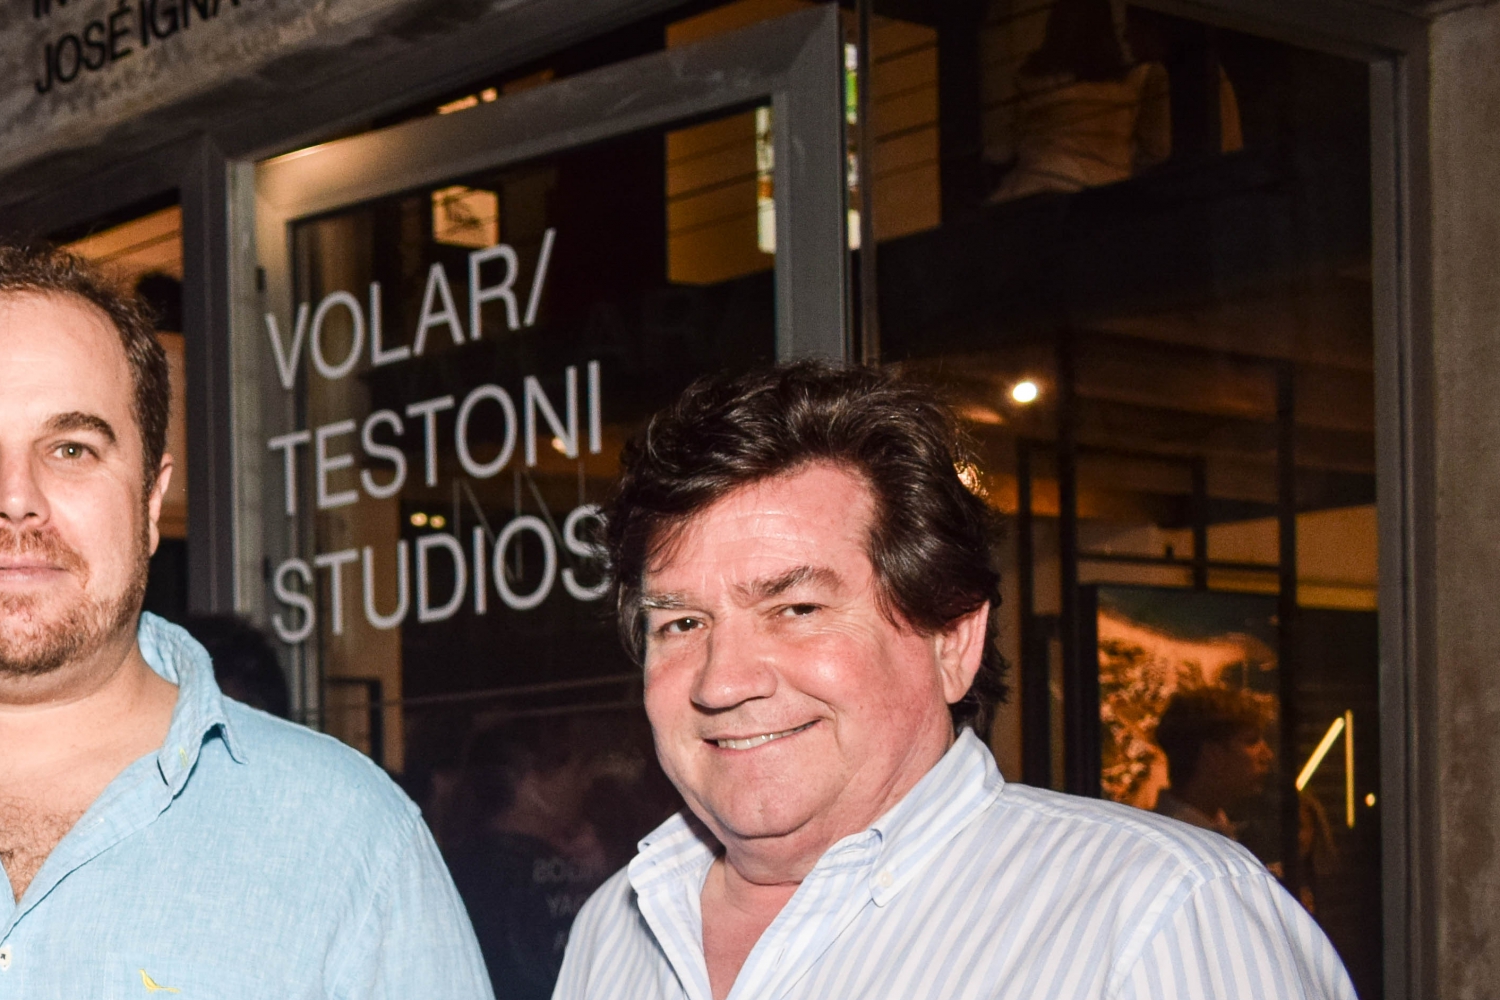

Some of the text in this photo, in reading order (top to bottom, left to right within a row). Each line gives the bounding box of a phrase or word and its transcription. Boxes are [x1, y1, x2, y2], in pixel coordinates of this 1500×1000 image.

[264, 227, 557, 391] VOLAR/
[267, 359, 602, 517] TESTONI
[271, 503, 611, 645] STUDIOS
